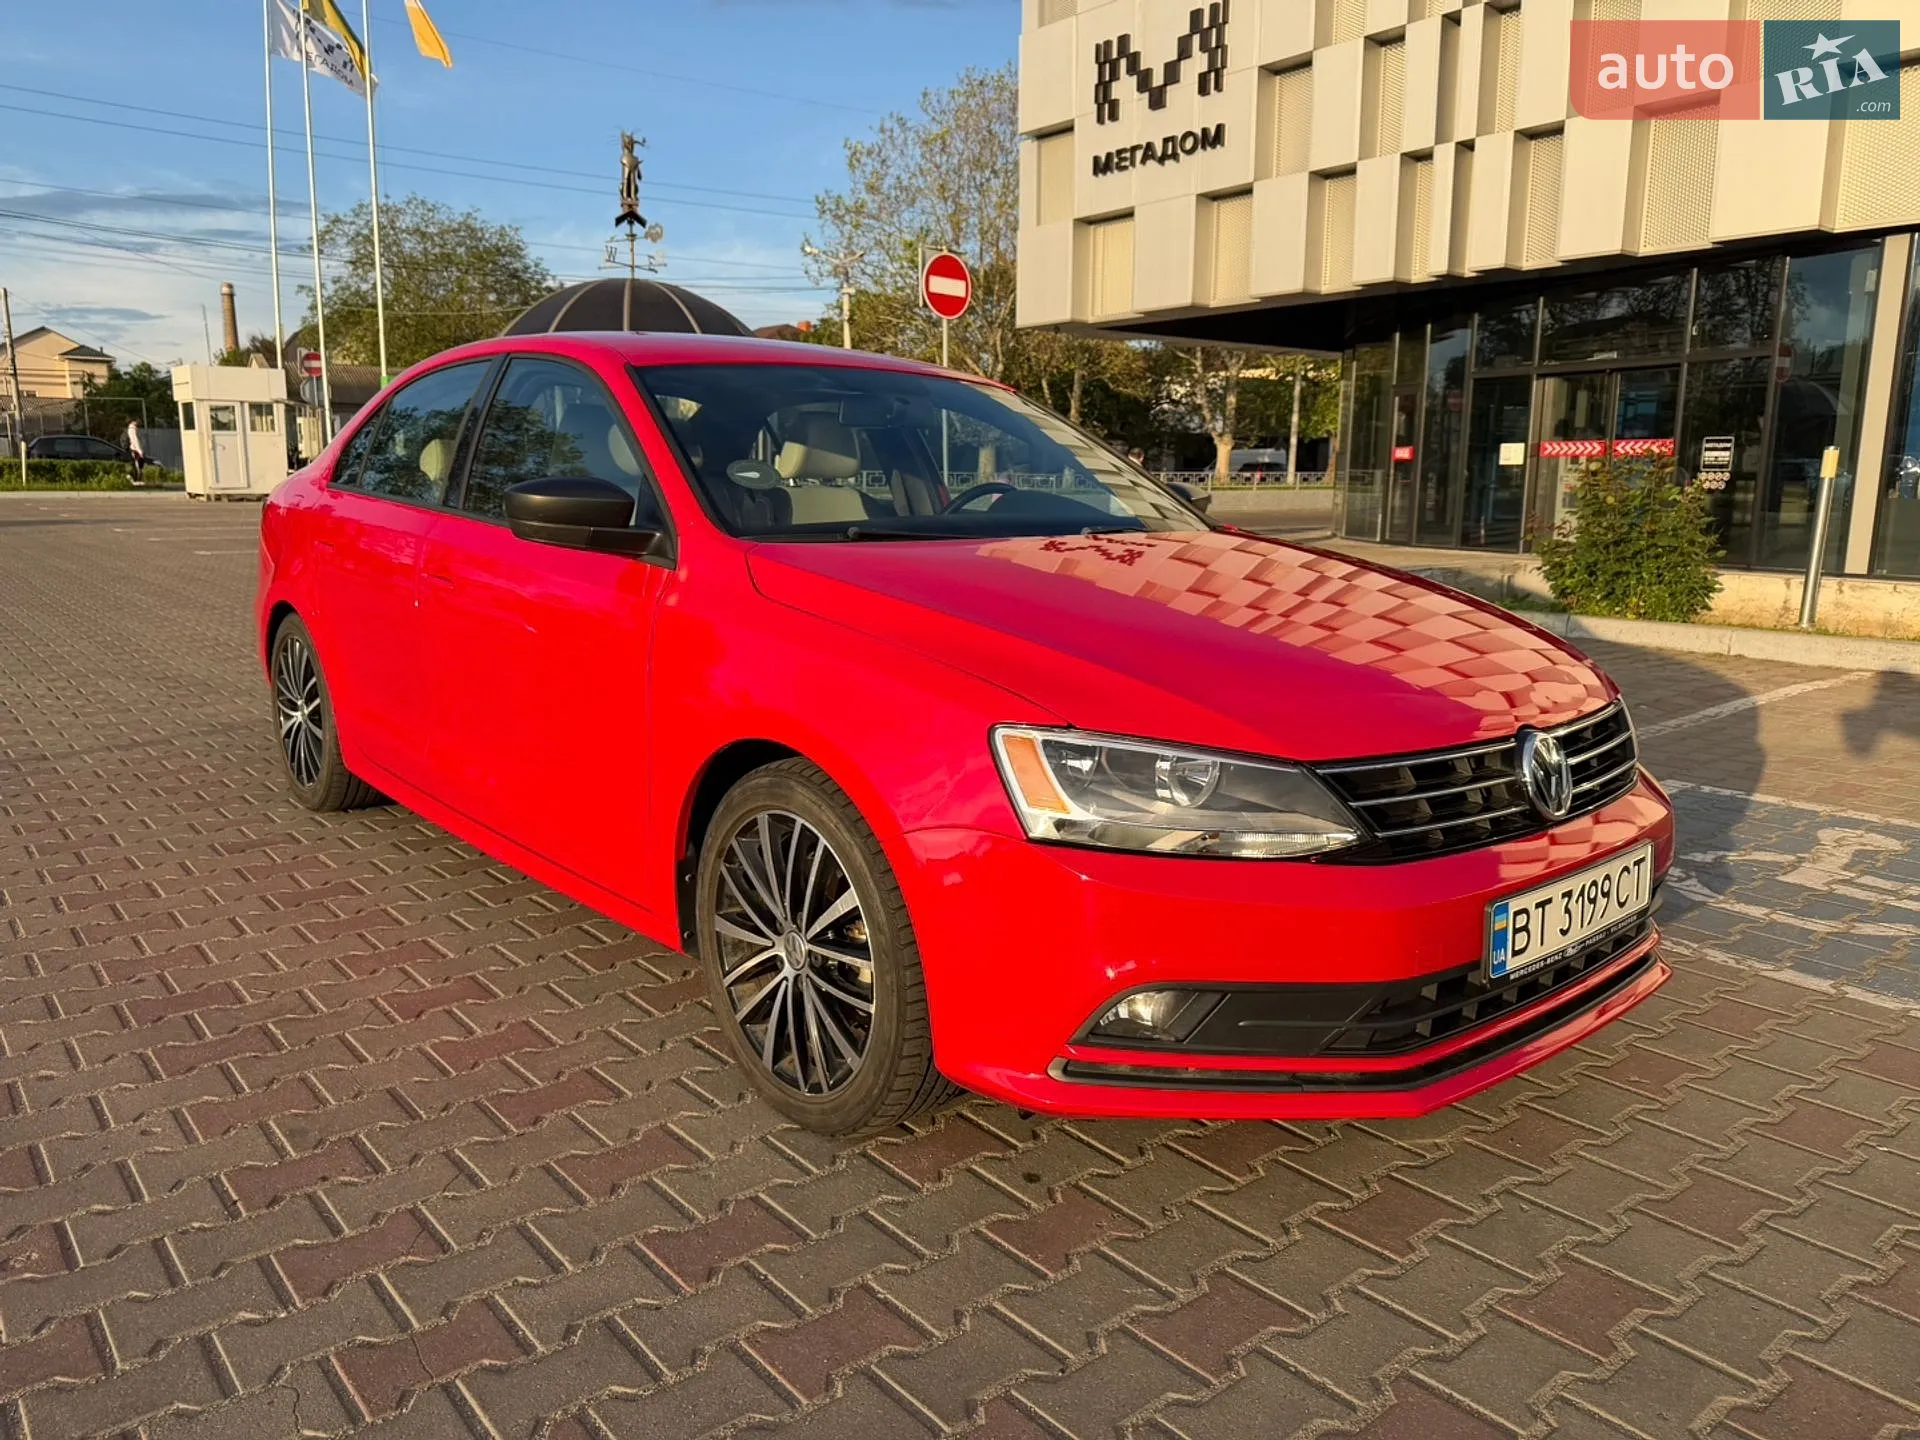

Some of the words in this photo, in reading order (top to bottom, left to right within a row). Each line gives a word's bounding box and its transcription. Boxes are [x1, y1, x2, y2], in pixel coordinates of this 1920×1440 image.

[1092, 123, 1226, 177] МЕГАДОМ
[1511, 897, 1553, 958] BT
[1558, 873, 1611, 936] 3199
[1616, 856, 1646, 909] CT
[1493, 948, 1505, 964] UA
[1509, 952, 1562, 980] MERCEDES-BENZ
